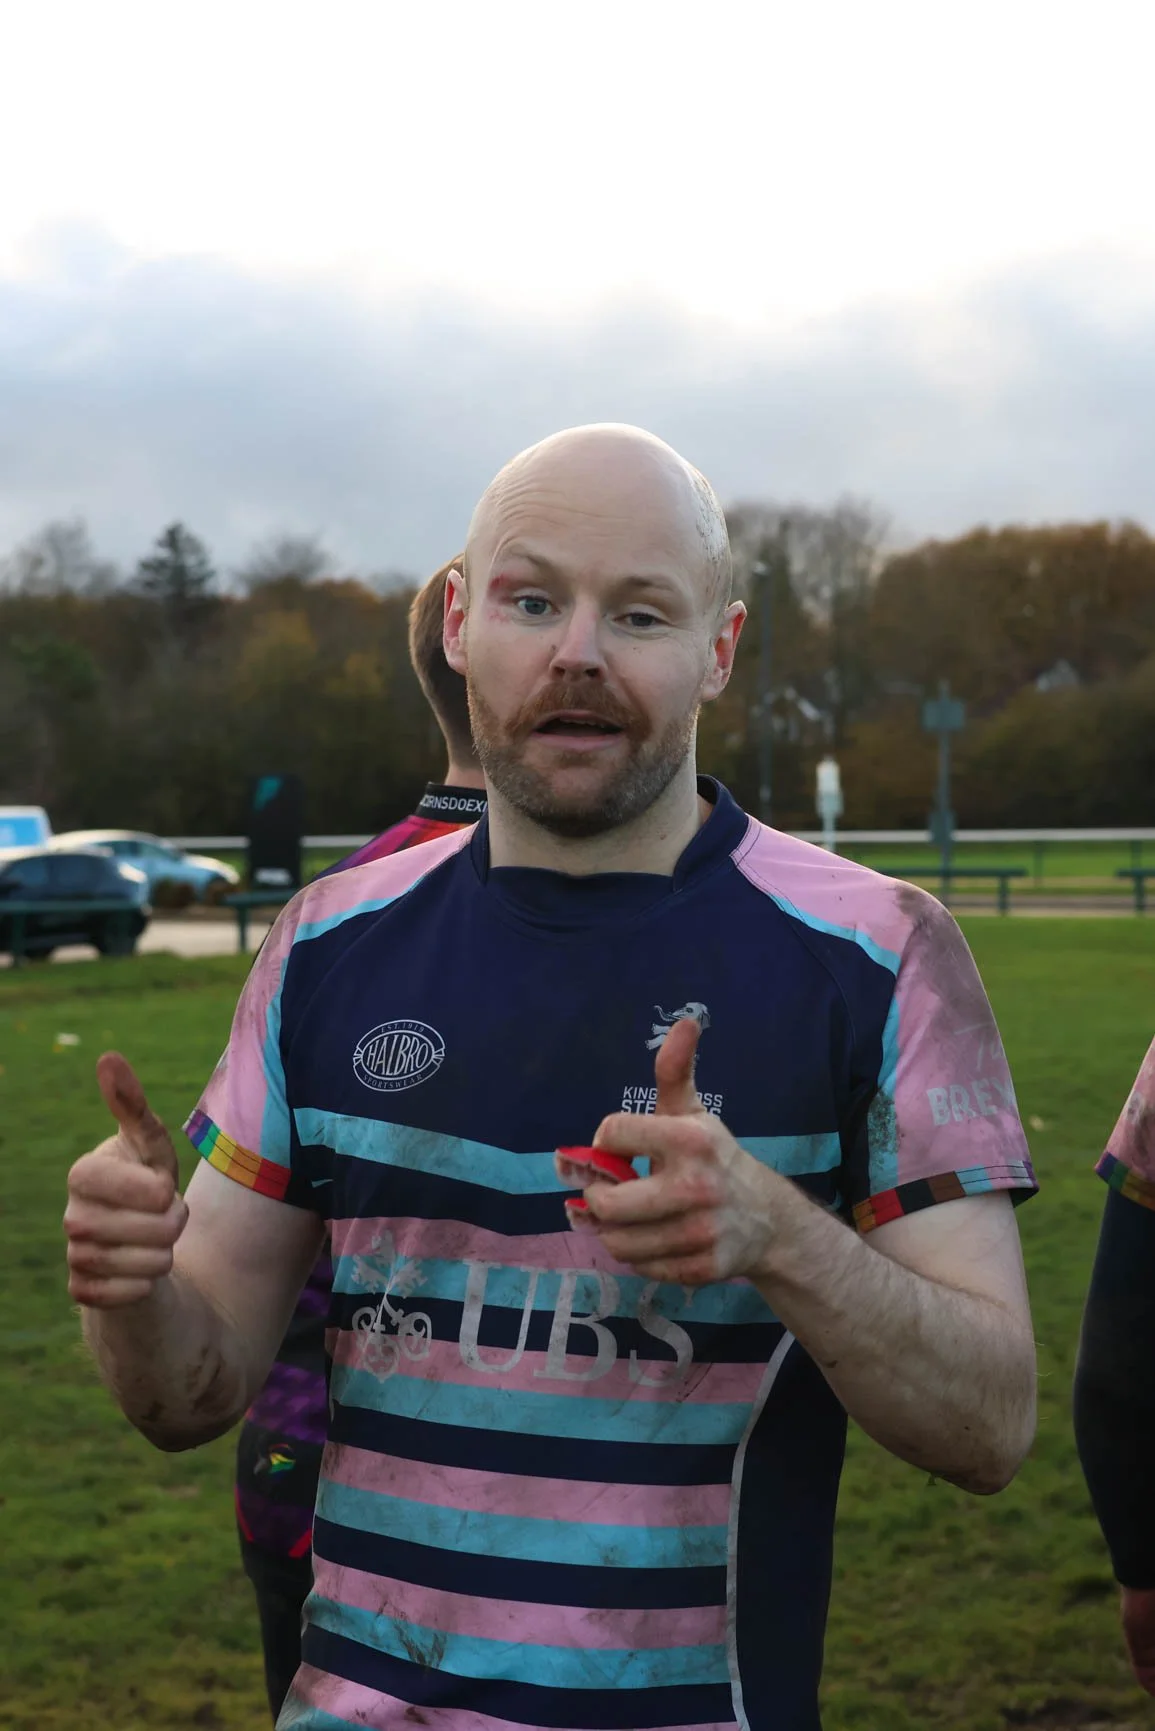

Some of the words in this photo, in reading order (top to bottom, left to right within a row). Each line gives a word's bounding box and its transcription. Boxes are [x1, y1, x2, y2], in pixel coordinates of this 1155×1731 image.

[366, 1034, 429, 1076] HALBRO
[363, 1073, 423, 1089] SPORTSWEAR
[458, 1257, 694, 1387] UBS
